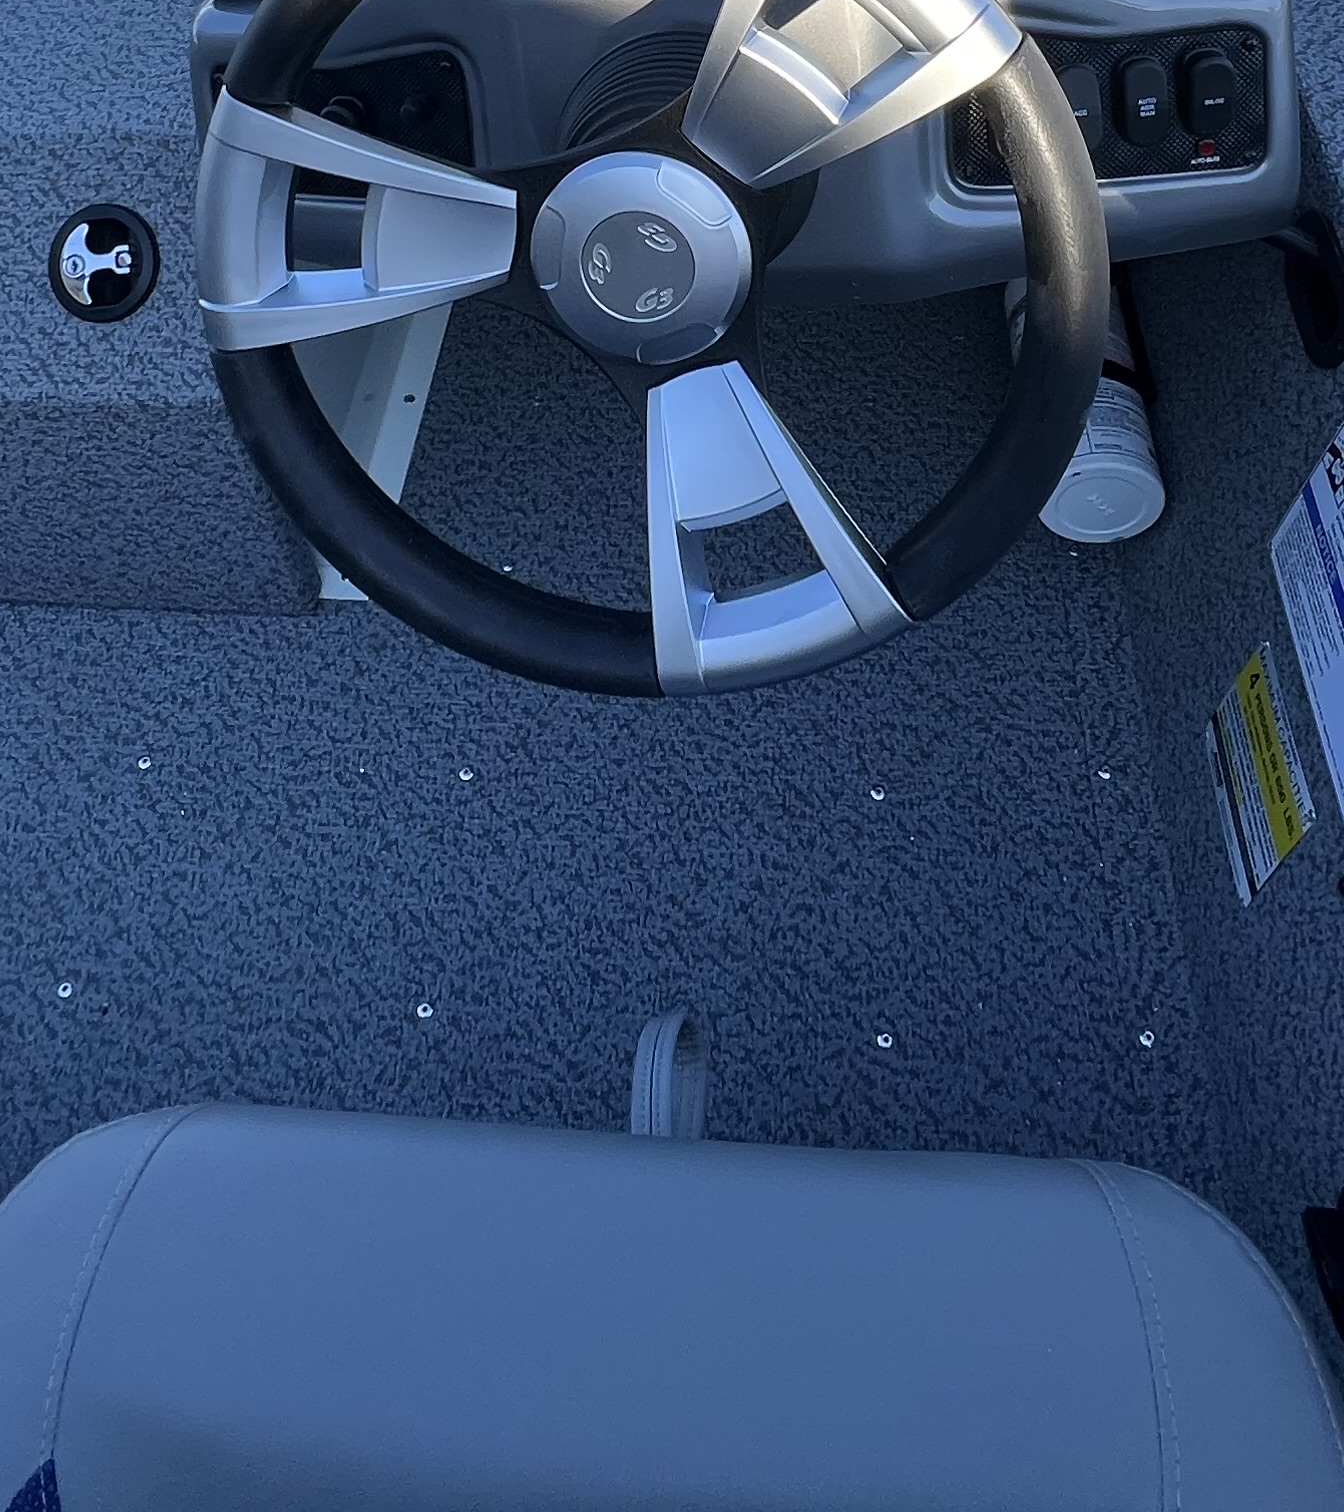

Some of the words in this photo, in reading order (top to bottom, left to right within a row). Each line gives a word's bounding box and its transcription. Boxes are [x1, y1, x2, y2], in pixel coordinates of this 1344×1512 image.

[637, 222, 677, 253] G3
[588, 242, 612, 285] G3
[636, 287, 674, 313] G3
[1316, 524, 1338, 585] NOTICE
[1249, 673, 1261, 690] 4
[1255, 692, 1274, 753] PERSONS
[1269, 753, 1279, 774] OR
